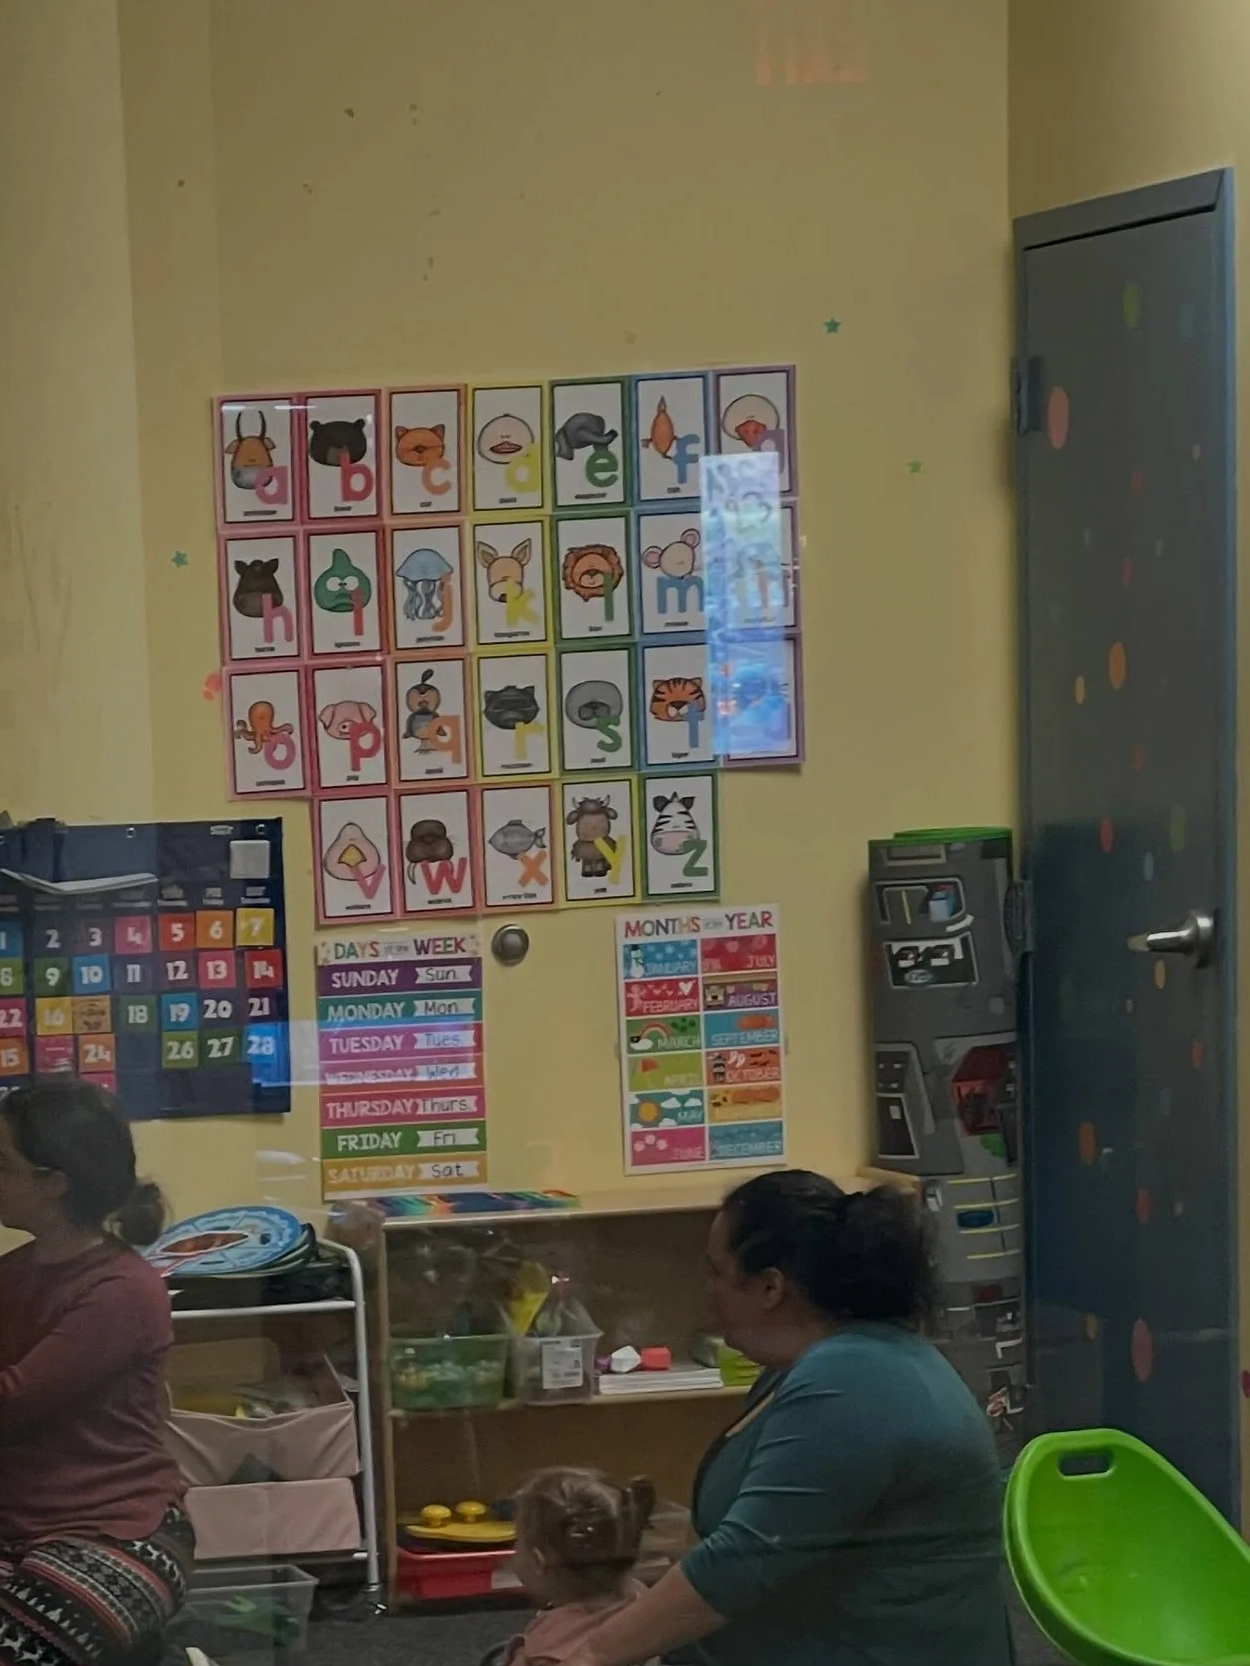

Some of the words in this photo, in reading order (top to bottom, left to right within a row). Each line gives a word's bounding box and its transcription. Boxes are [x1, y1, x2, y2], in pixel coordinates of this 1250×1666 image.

[254, 465, 288, 505] a
[339, 449, 374, 502] b
[421, 458, 453, 496] c
[504, 442, 540, 494] d
[585, 449, 619, 488] e
[671, 433, 700, 484] f
[261, 592, 294, 644] h
[505, 577, 542, 628] k
[656, 574, 705, 614] m
[263, 731, 297, 771] o
[350, 721, 382, 772] p
[425, 714, 462, 765] q
[514, 721, 545, 760] r
[595, 714, 623, 753] s
[350, 863, 387, 900] v
[420, 856, 468, 896] w
[517, 850, 549, 889] x
[592, 833, 628, 885] y
[682, 838, 709, 877] z
[0, 930, 8, 950] 1
[45, 928, 61, 949] 2
[88, 926, 102, 947] 3
[126, 925, 142, 945] 4
[170, 922, 185, 943] 5
[209, 919, 223, 940] 6
[250, 916, 265, 935] 7
[624, 916, 701, 939] MONTHS
[724, 910, 774, 932] YEAR
[333, 940, 381, 961] DAYS
[412, 936, 467, 957] WEEK
[45, 966, 61, 986] 9
[80, 964, 103, 984] 10
[125, 963, 141, 983] 11
[166, 960, 189, 981] 12
[205, 959, 228, 980] 13
[252, 958, 275, 979] 14
[747, 953, 776, 970] JULY
[330, 968, 400, 989] SUNDAY
[126, 1004, 149, 1025] 18
[169, 1002, 191, 1022] 19
[202, 999, 233, 1019] 20
[248, 996, 271, 1017] 21
[326, 1001, 406, 1023] MONDAY
[423, 1001, 459, 1015] Mon
[641, 997, 699, 1015] FEBRUARY
[726, 991, 777, 1009] AUGUST
[83, 1043, 112, 1064] 24
[166, 1040, 194, 1060] 26
[206, 1036, 235, 1058] 27
[246, 1034, 276, 1056] 28
[328, 1033, 405, 1055] TUESDAY
[325, 1098, 418, 1120] THURSDAY
[336, 1130, 403, 1153] FRIDAY
[433, 1130, 456, 1146] Fri
[326, 1163, 417, 1185] SATURDAY
[430, 1163, 464, 1179] Sat
